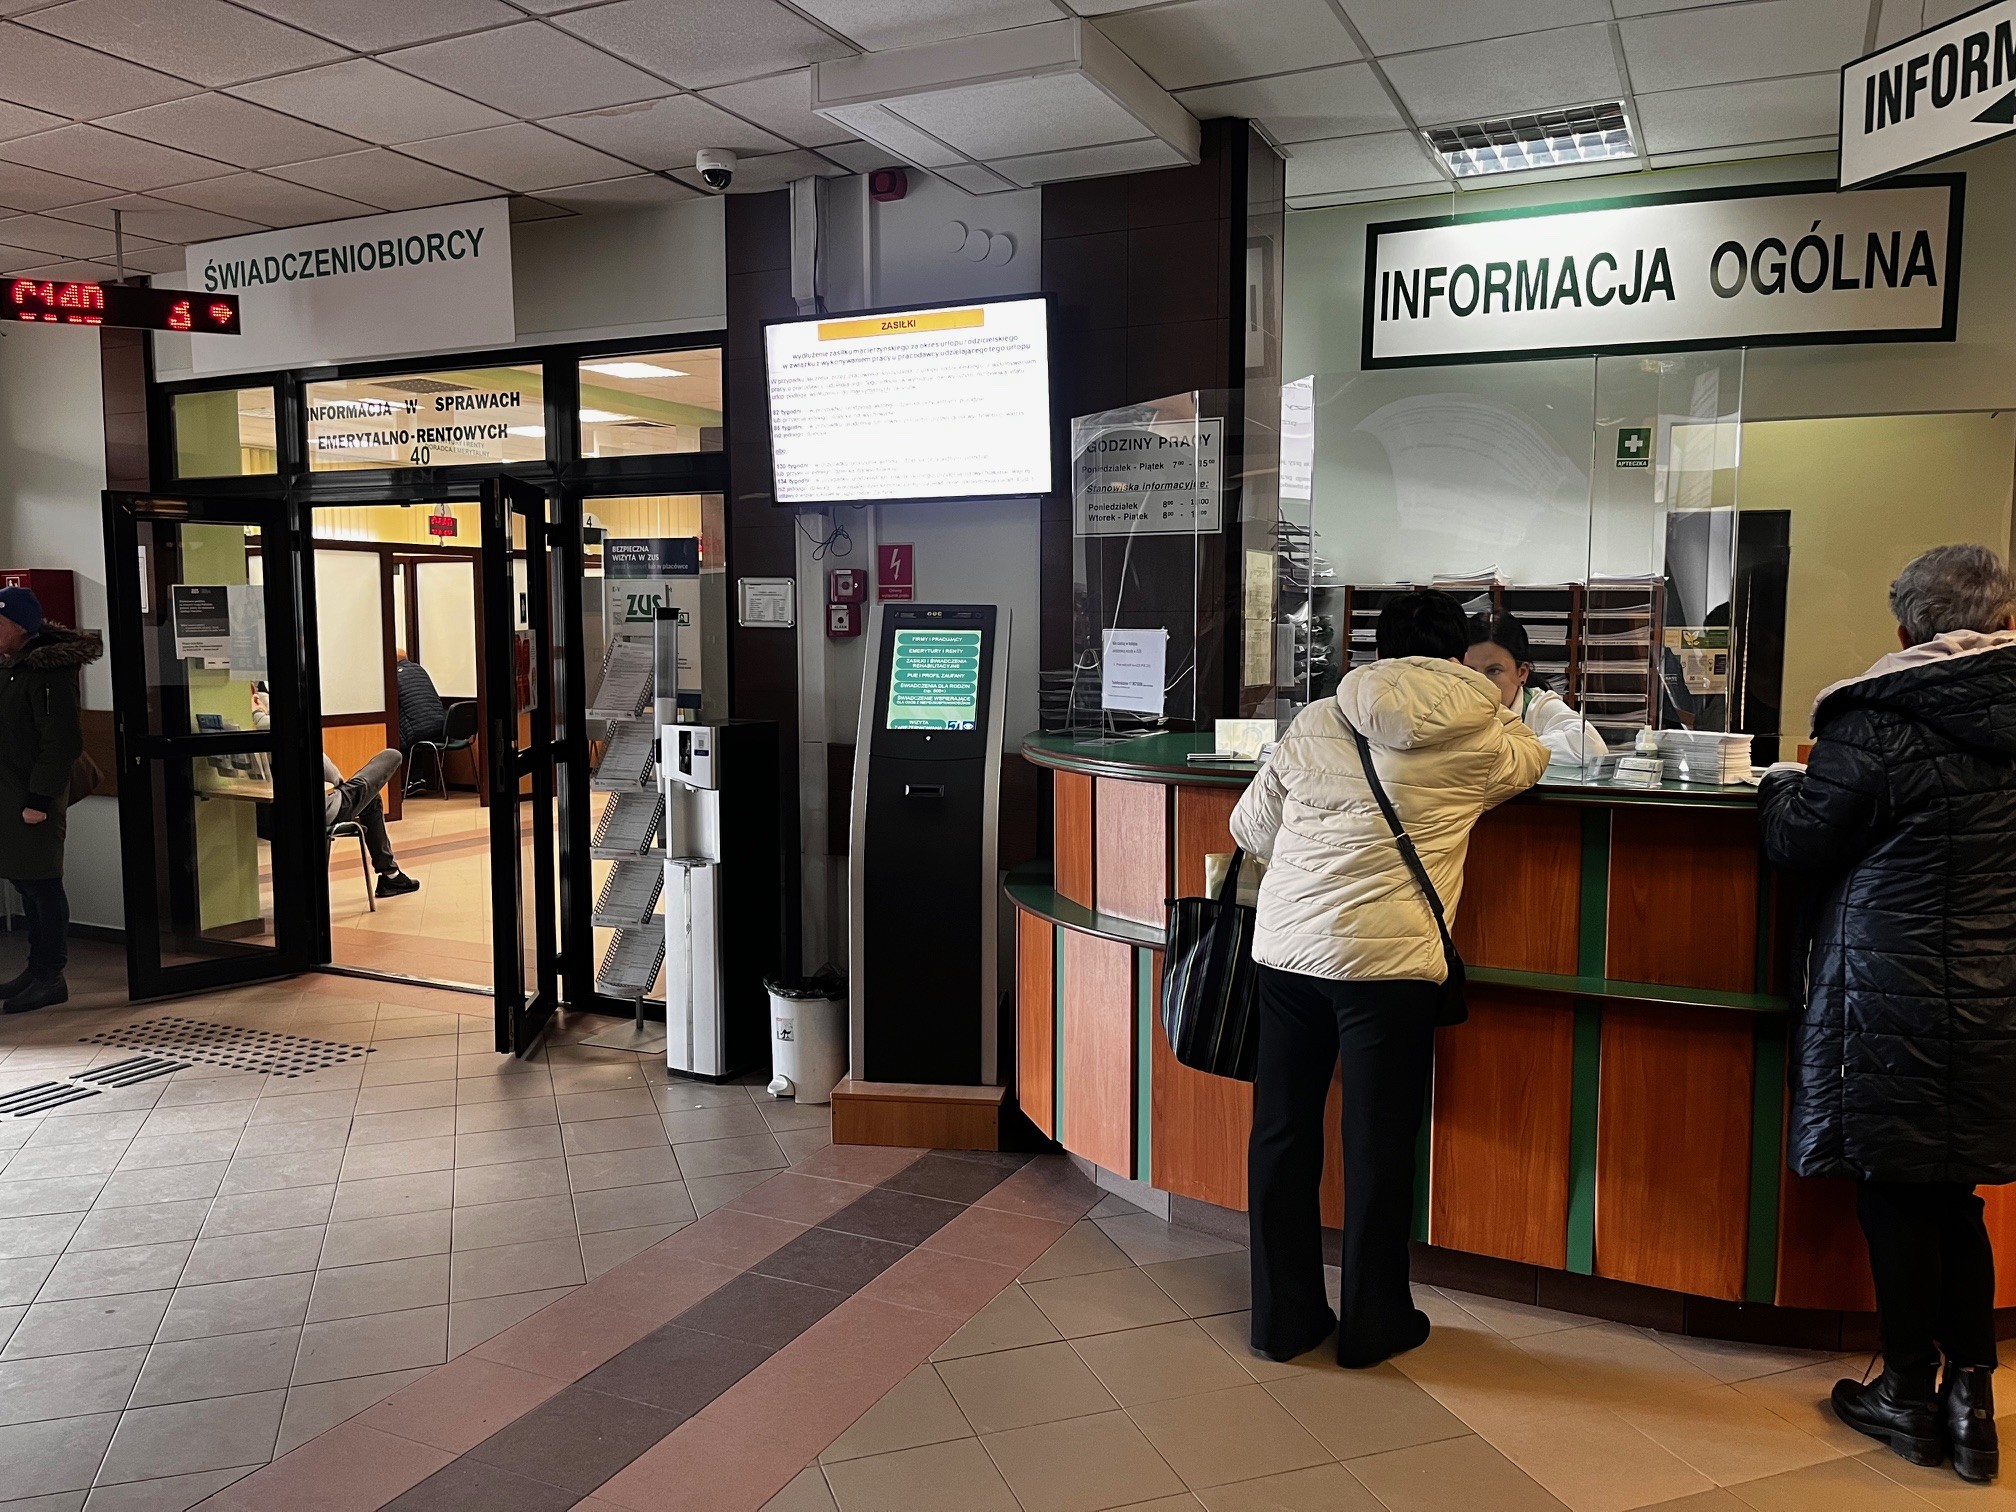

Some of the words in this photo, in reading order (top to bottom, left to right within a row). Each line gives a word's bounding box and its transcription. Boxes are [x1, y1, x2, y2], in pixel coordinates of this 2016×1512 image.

[204, 227, 485, 293] ŚWIADCZENIOBIORCY
[1381, 247, 1676, 322] INFORMACJA
[1710, 220, 1937, 299] OGÓLNA
[881, 319, 916, 331] ZASIŁKI
[306, 401, 392, 421] INFORMACJA
[405, 399, 418, 414] W
[435, 391, 520, 412] SPRAWACH
[318, 423, 508, 450] EMERYTALNO-RENTOWYCH
[1087, 437, 1152, 453] GODZINY
[410, 446, 430, 465] 40
[1140, 462, 1164, 471] Piątek
[586, 515, 592, 528] 4
[1088, 513, 1115, 522] Wtorek
[647, 553, 660, 561] ZUS
[662, 563, 689, 571] placówce
[627, 594, 663, 616] ZUS
